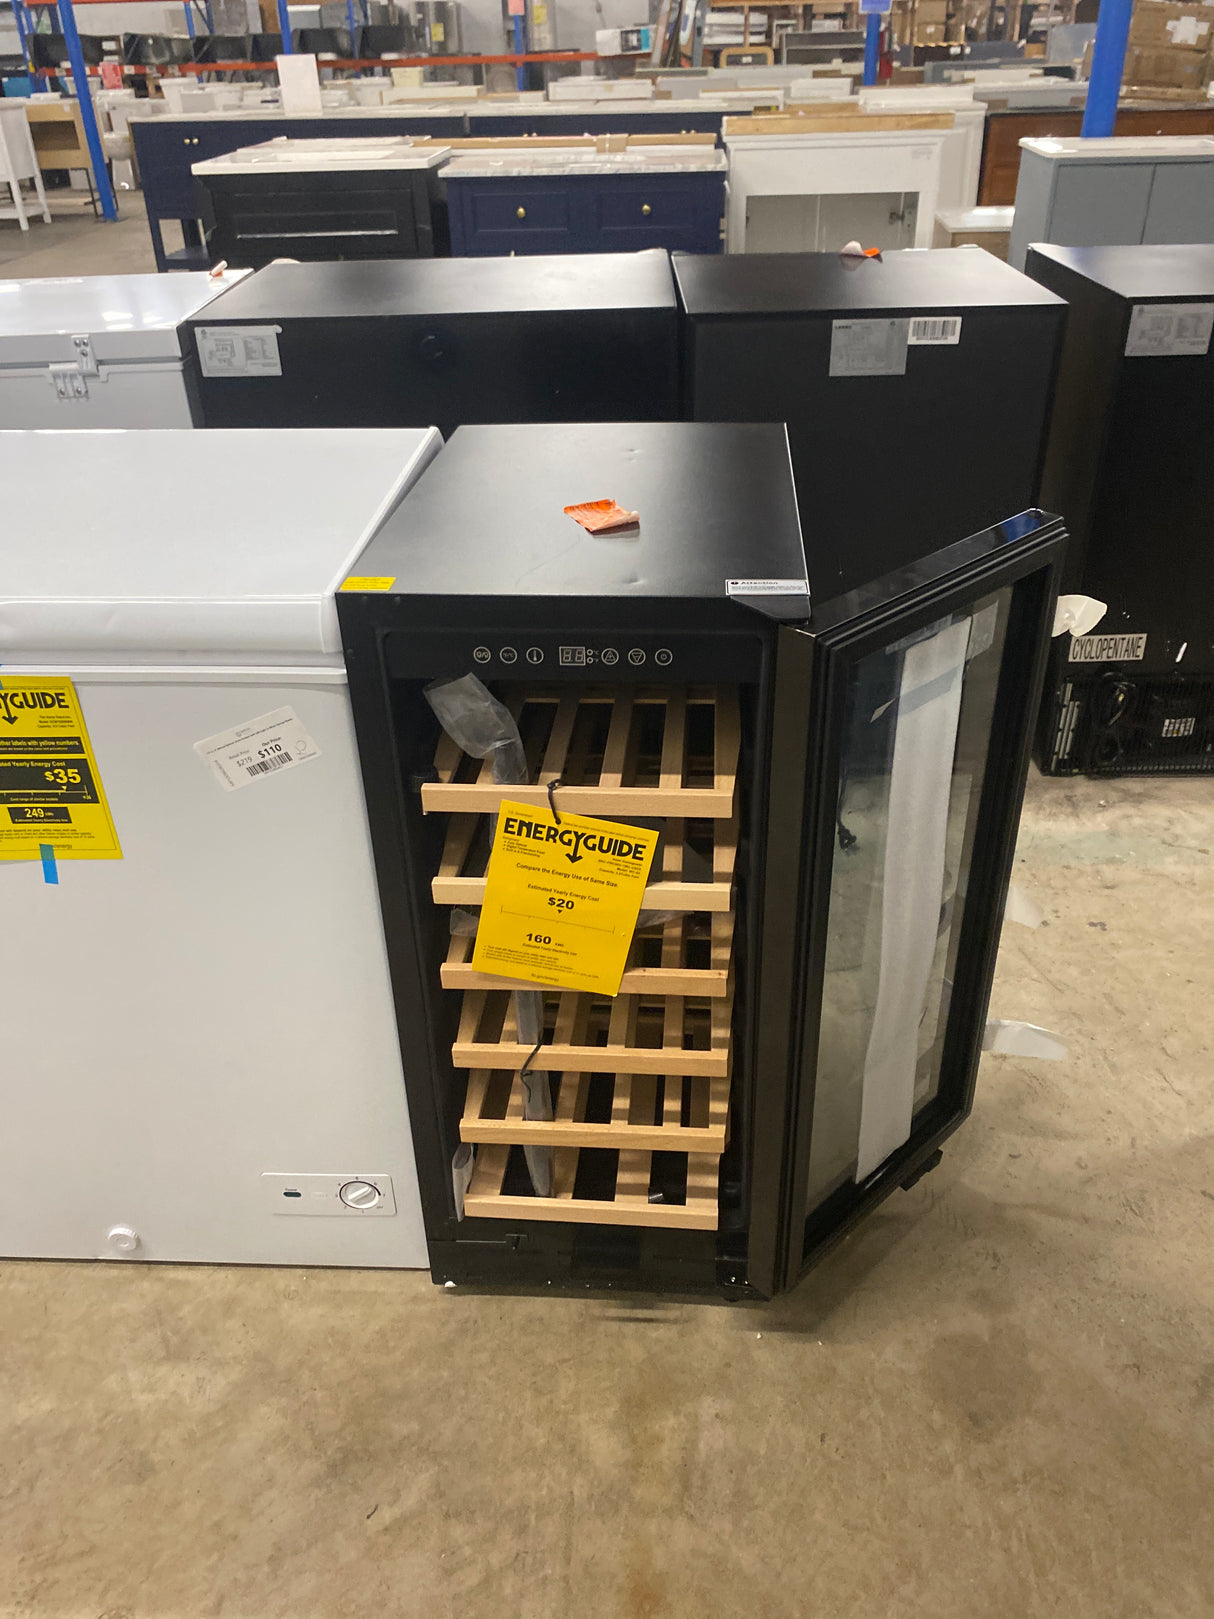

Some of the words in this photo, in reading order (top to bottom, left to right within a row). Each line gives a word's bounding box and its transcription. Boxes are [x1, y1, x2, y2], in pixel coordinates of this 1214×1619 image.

[1073, 637, 1143, 659] CYCLOPENTANE
[0, 692, 69, 716] YGUIDE
[257, 744, 282, 759] $110
[44, 768, 82, 784] $35
[24, 808, 45, 818] 249
[503, 817, 647, 862] ENERGYGUIDE
[516, 862, 541, 874] Compare
[551, 869, 571, 880] Energy
[590, 877, 606, 885] Same
[527, 883, 552, 894] Estimated
[553, 887, 568, 897] Yearly
[569, 890, 587, 901] Energy
[587, 894, 600, 903] Cost
[547, 896, 575, 911] $20
[526, 933, 552, 945] 160
